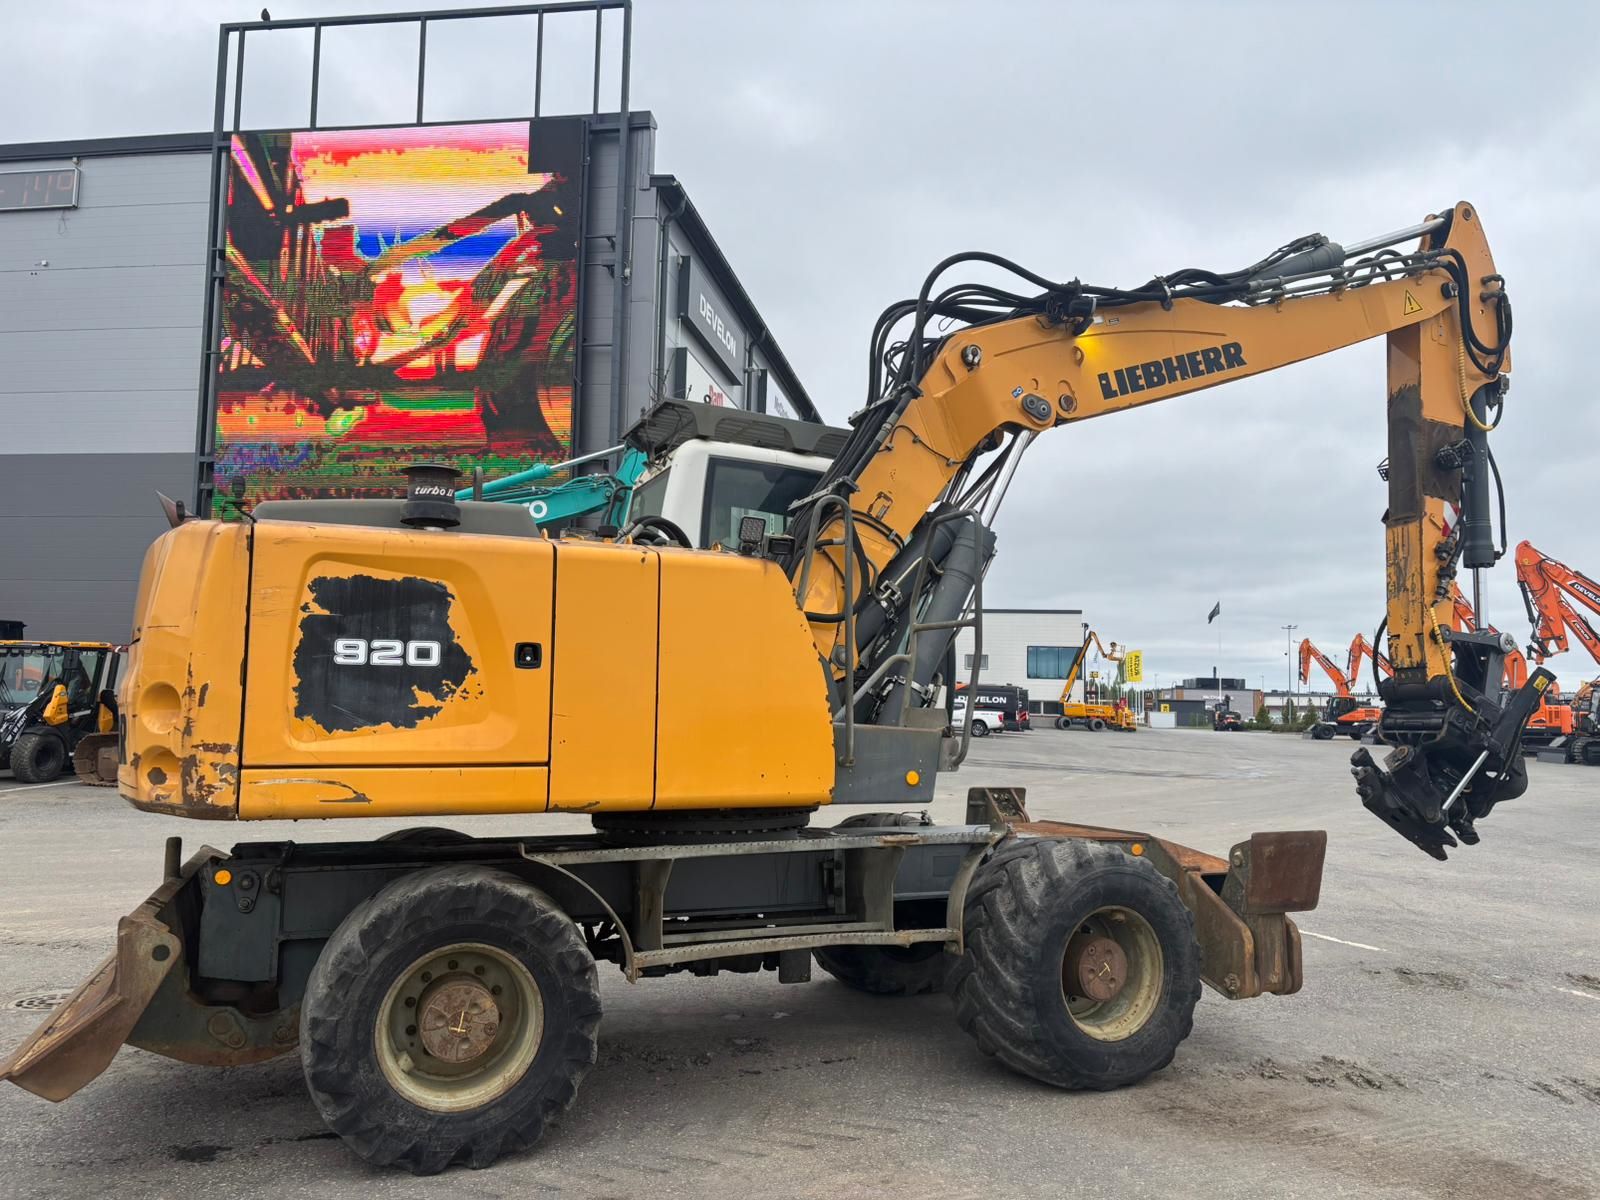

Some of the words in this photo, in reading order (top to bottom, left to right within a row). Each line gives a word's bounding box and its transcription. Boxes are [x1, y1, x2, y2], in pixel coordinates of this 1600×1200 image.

[700, 293, 736, 357] DEVELON
[1097, 341, 1247, 400] LIEBHERR
[415, 486, 445, 495] turbo
[333, 638, 441, 666] 920
[958, 695, 1007, 704] DVELON
